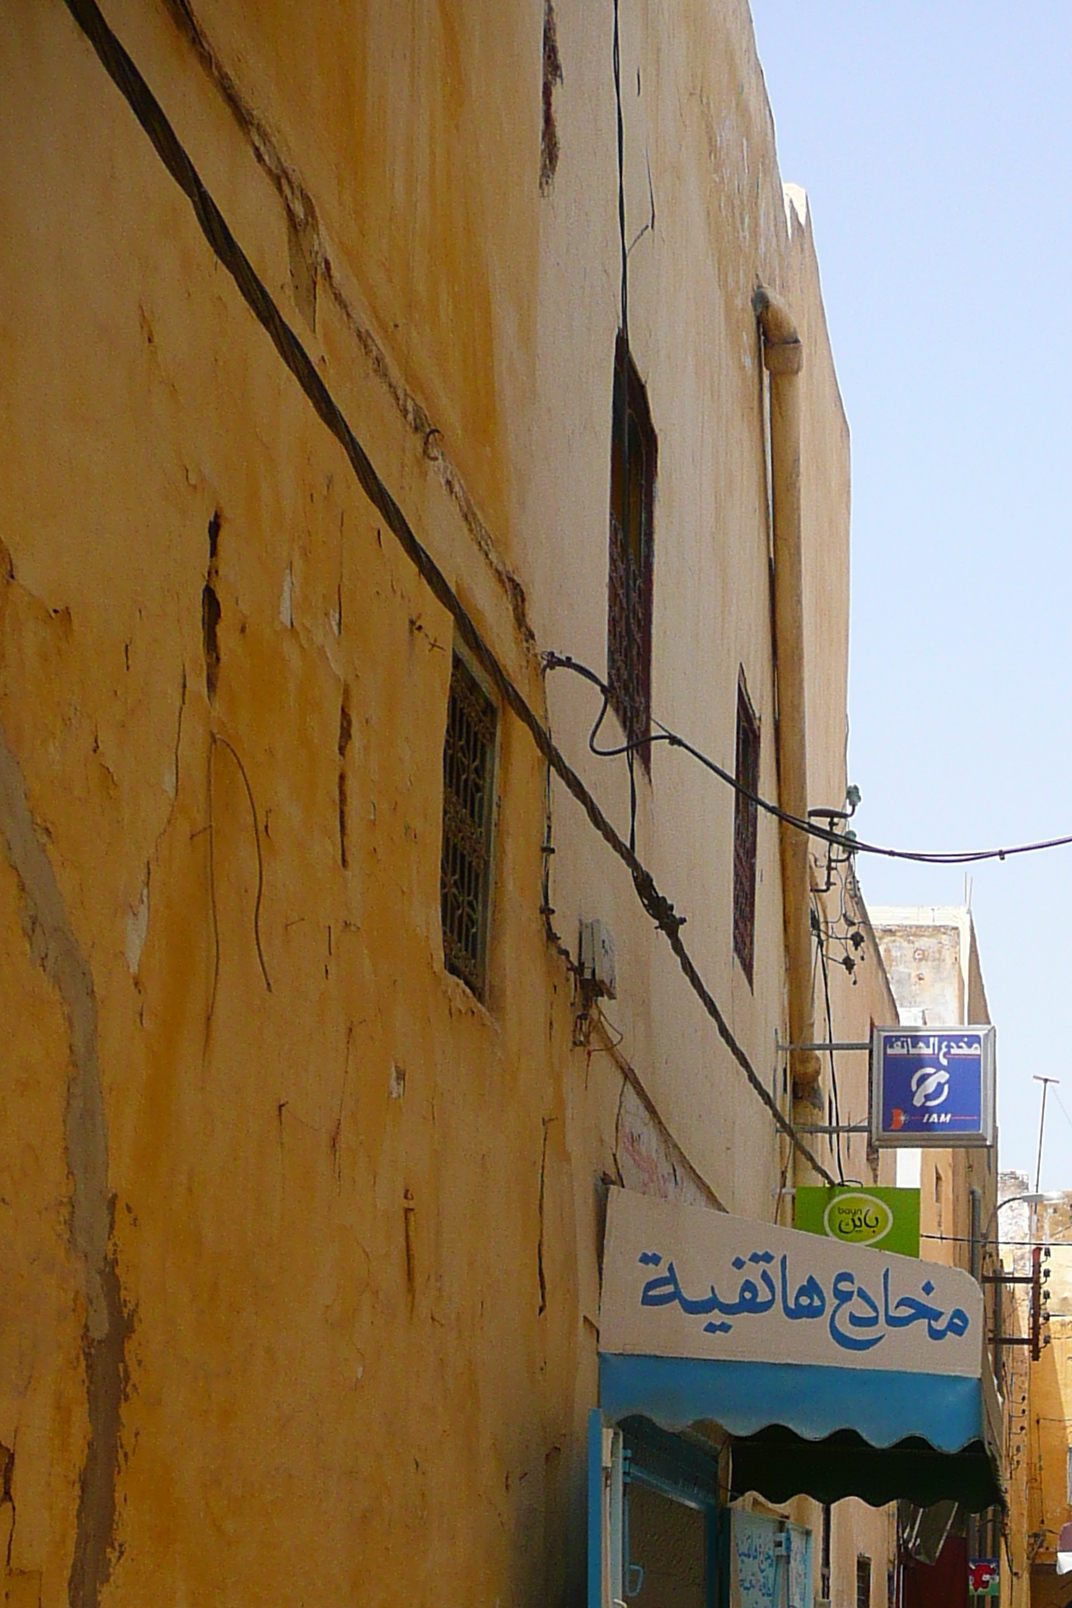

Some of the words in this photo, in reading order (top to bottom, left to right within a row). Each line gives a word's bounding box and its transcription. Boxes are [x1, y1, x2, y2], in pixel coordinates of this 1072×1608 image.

[886, 1036, 938, 1055] الهاتف
[939, 1037, 981, 1066] مخدع
[922, 1113, 952, 1123] IAM
[838, 1206, 863, 1217] bayn
[638, 1250, 827, 1335] هاتفية
[829, 1267, 970, 1351] مخادع
